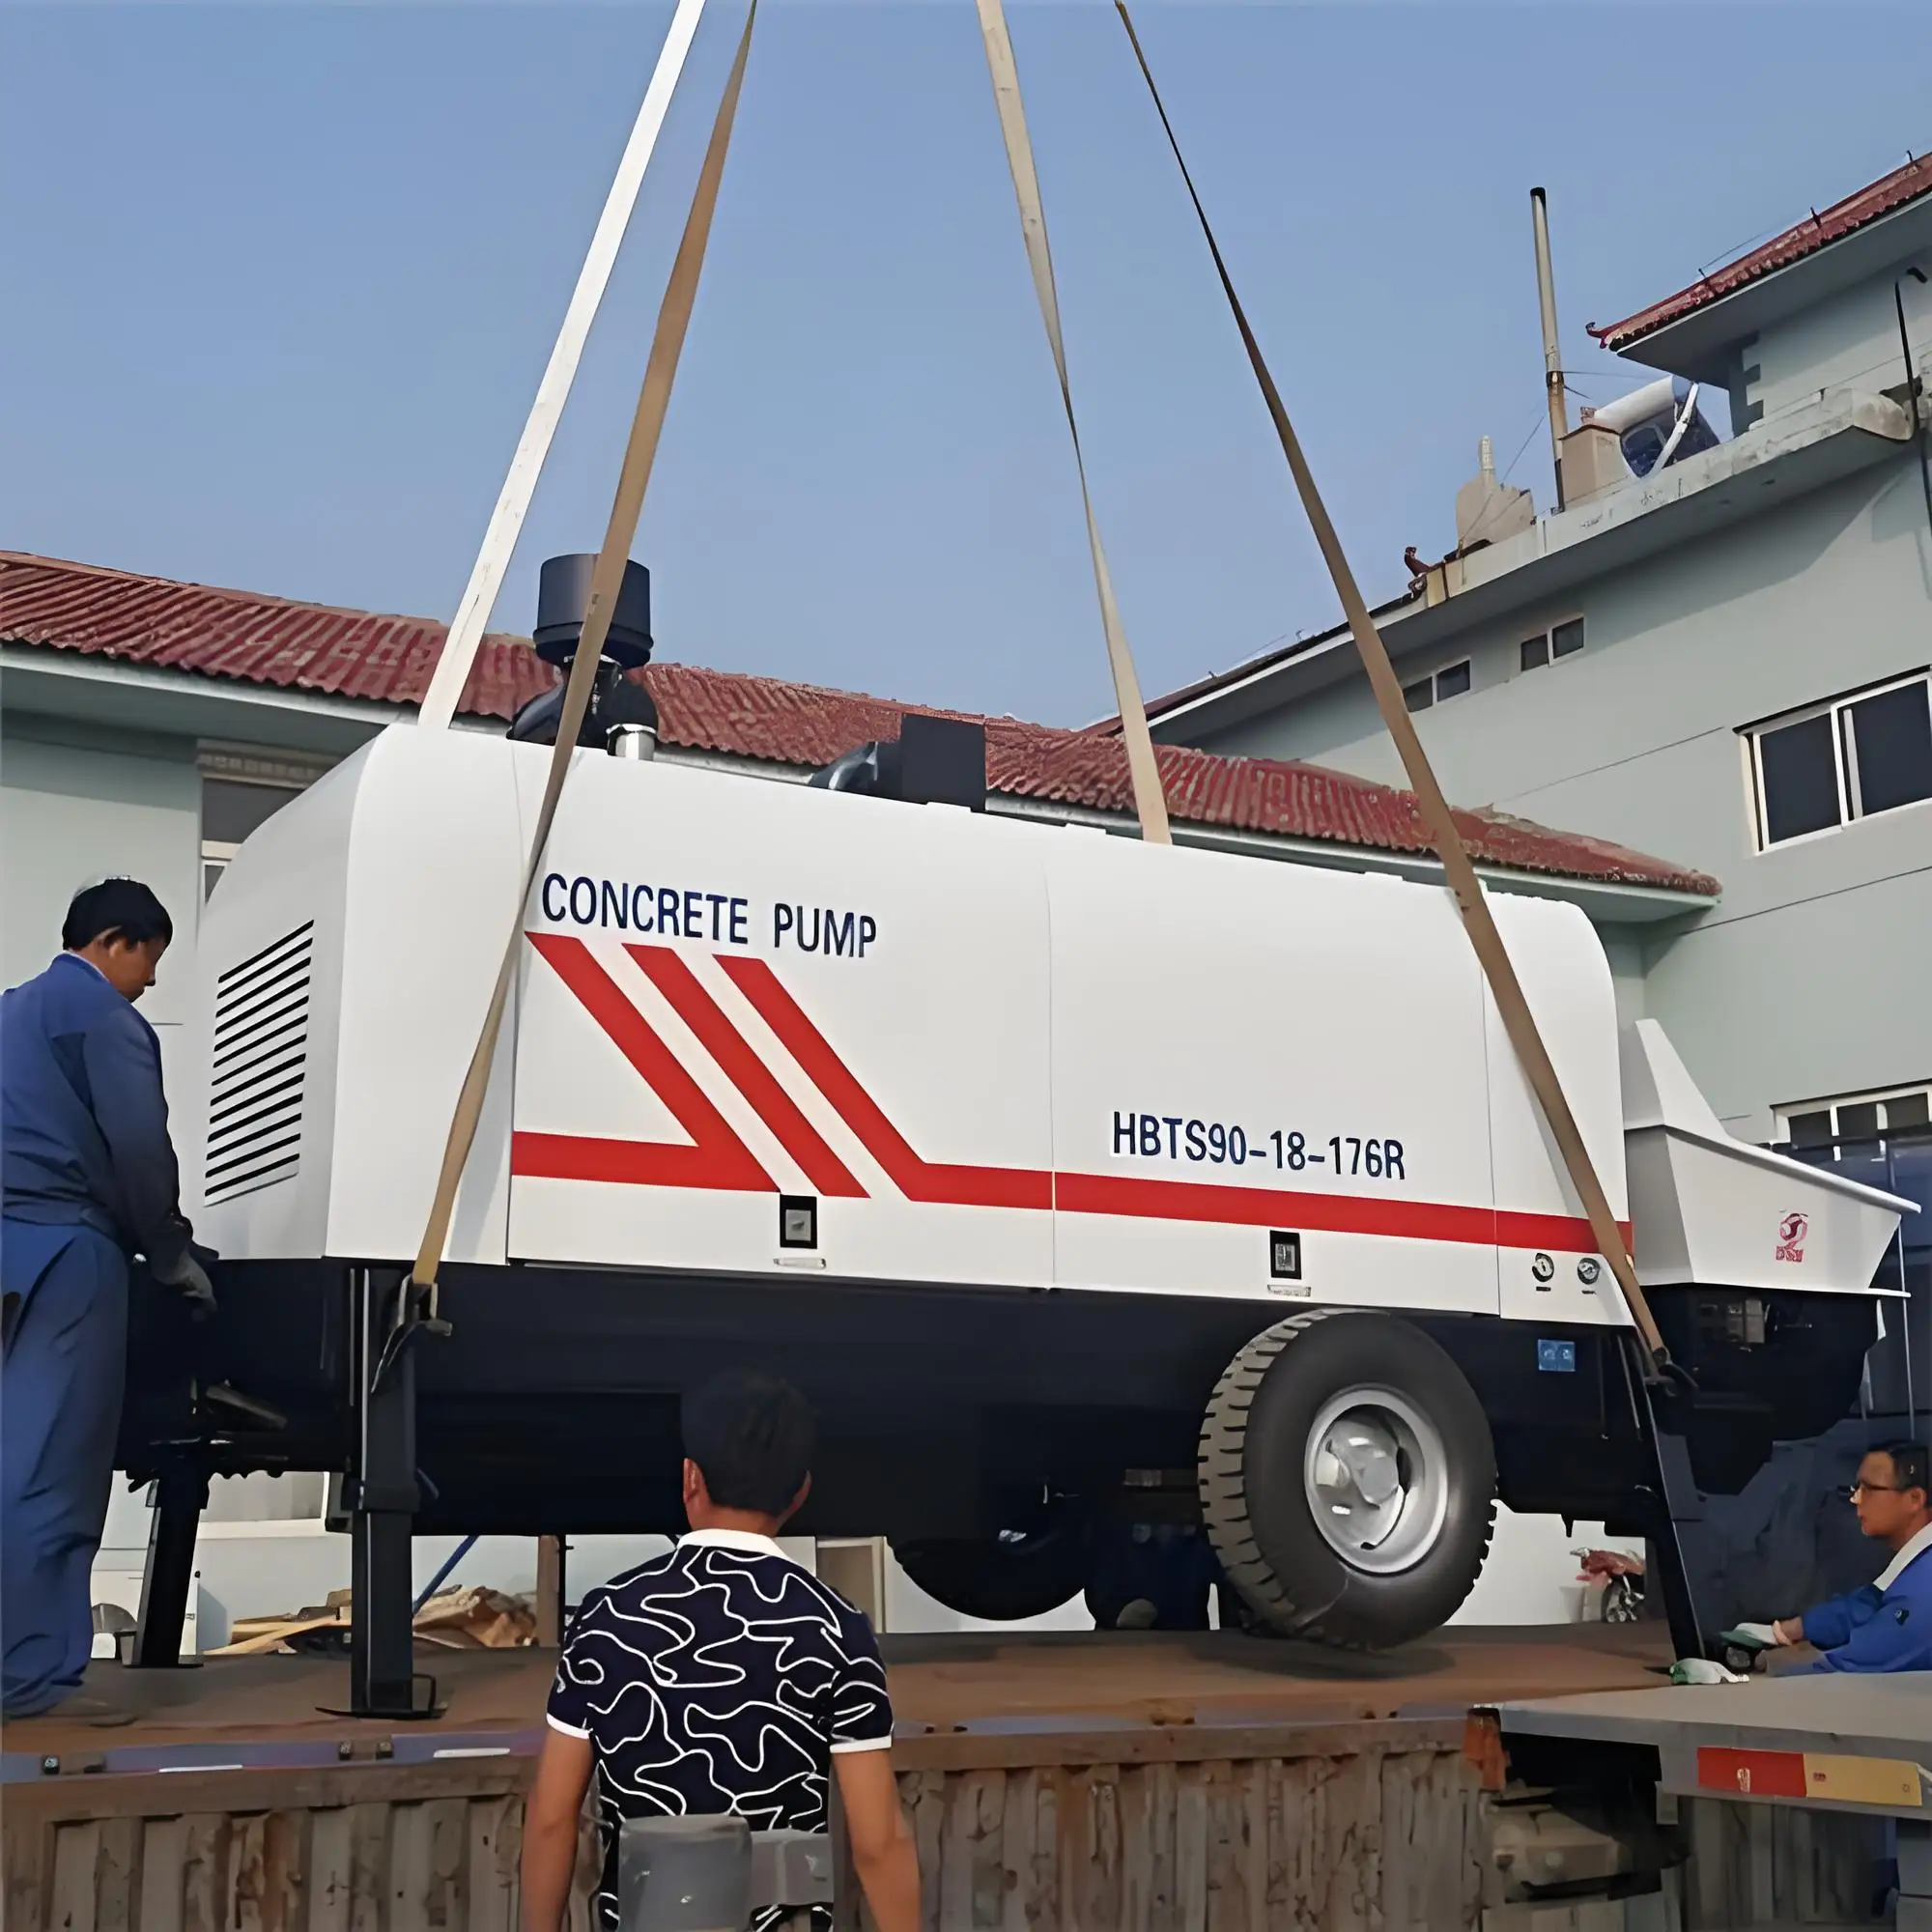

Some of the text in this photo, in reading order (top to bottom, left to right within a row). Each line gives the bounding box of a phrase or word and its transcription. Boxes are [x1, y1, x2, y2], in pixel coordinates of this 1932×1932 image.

[543, 872, 877, 958] CONCRETE PUMP
[1113, 1111, 1406, 1180] HBTS90-18-176R
